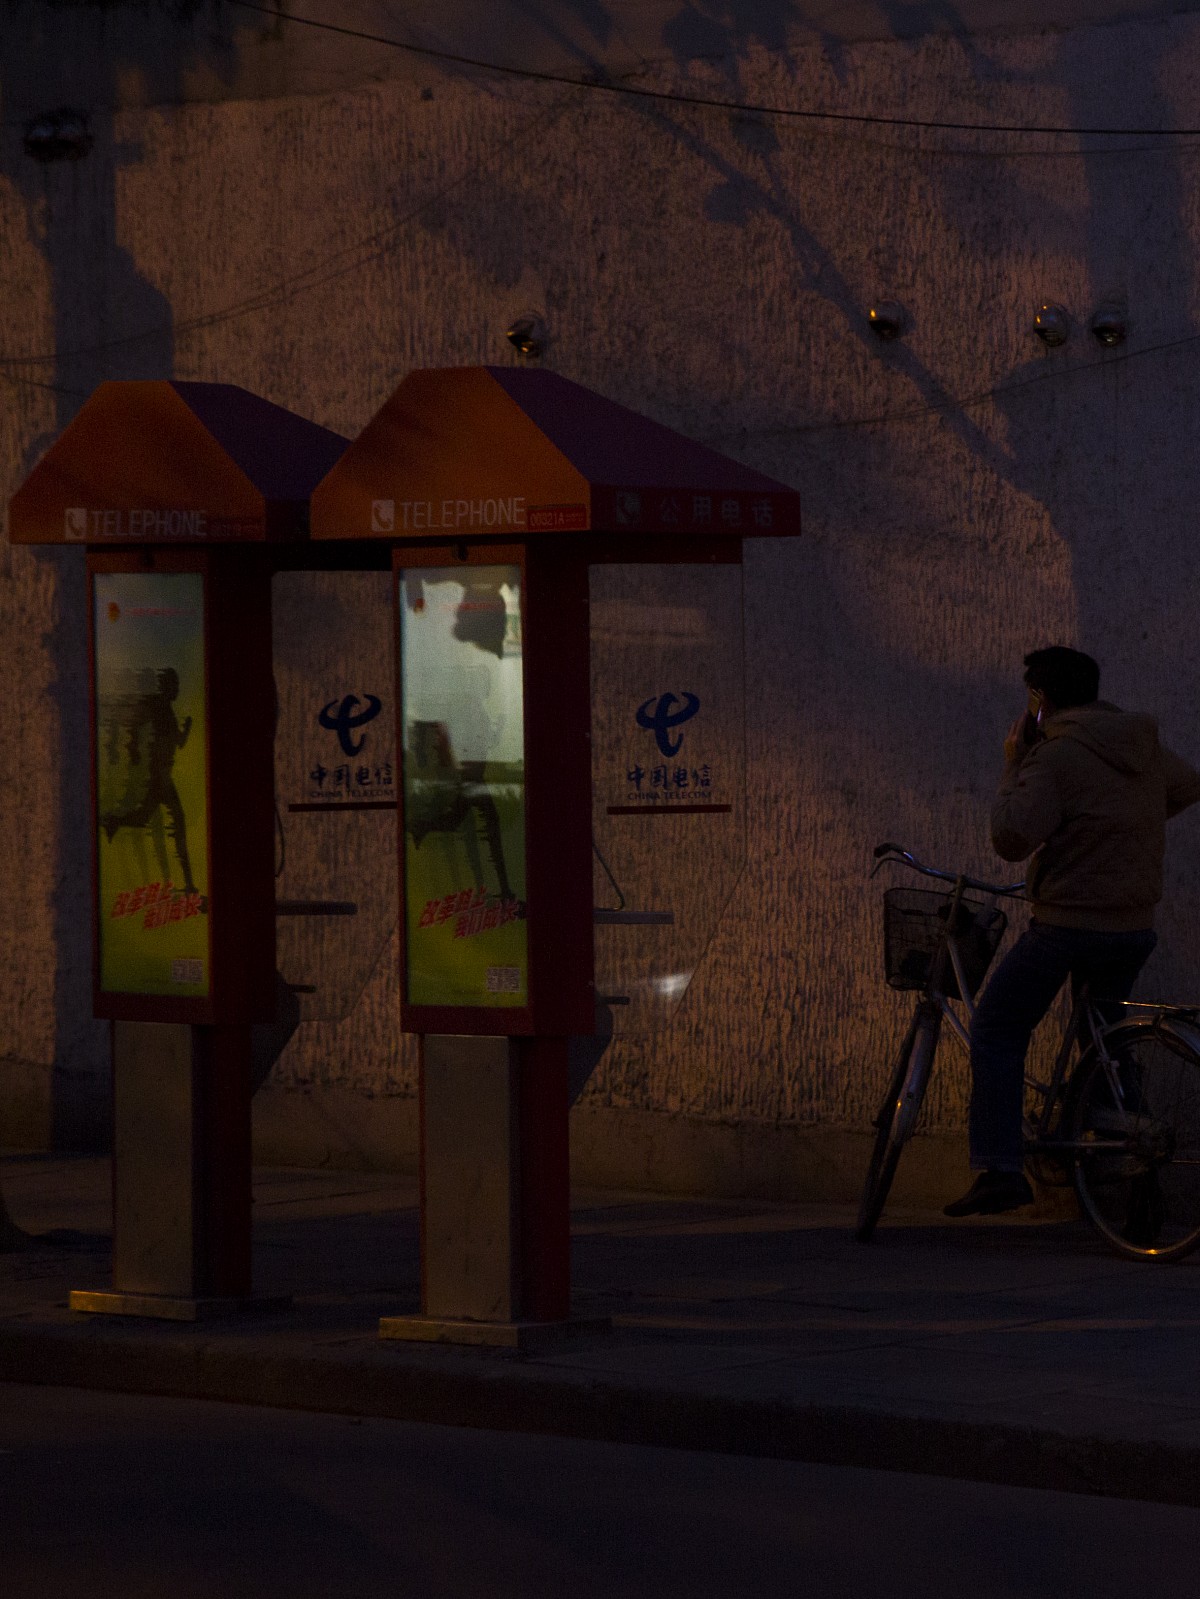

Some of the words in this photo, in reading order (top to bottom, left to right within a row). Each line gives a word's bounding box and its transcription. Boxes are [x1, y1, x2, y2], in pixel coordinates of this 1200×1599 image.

[91, 509, 208, 537] TELEPHONE
[400, 497, 525, 529] TELEPHONE
[660, 495, 774, 529] 公用电话
[310, 763, 392, 788] 中国电信
[626, 764, 711, 790] 中国电信
[310, 790, 342, 798] CHINA
[627, 791, 660, 800] CHINA
[663, 791, 712, 800] TELECOM
